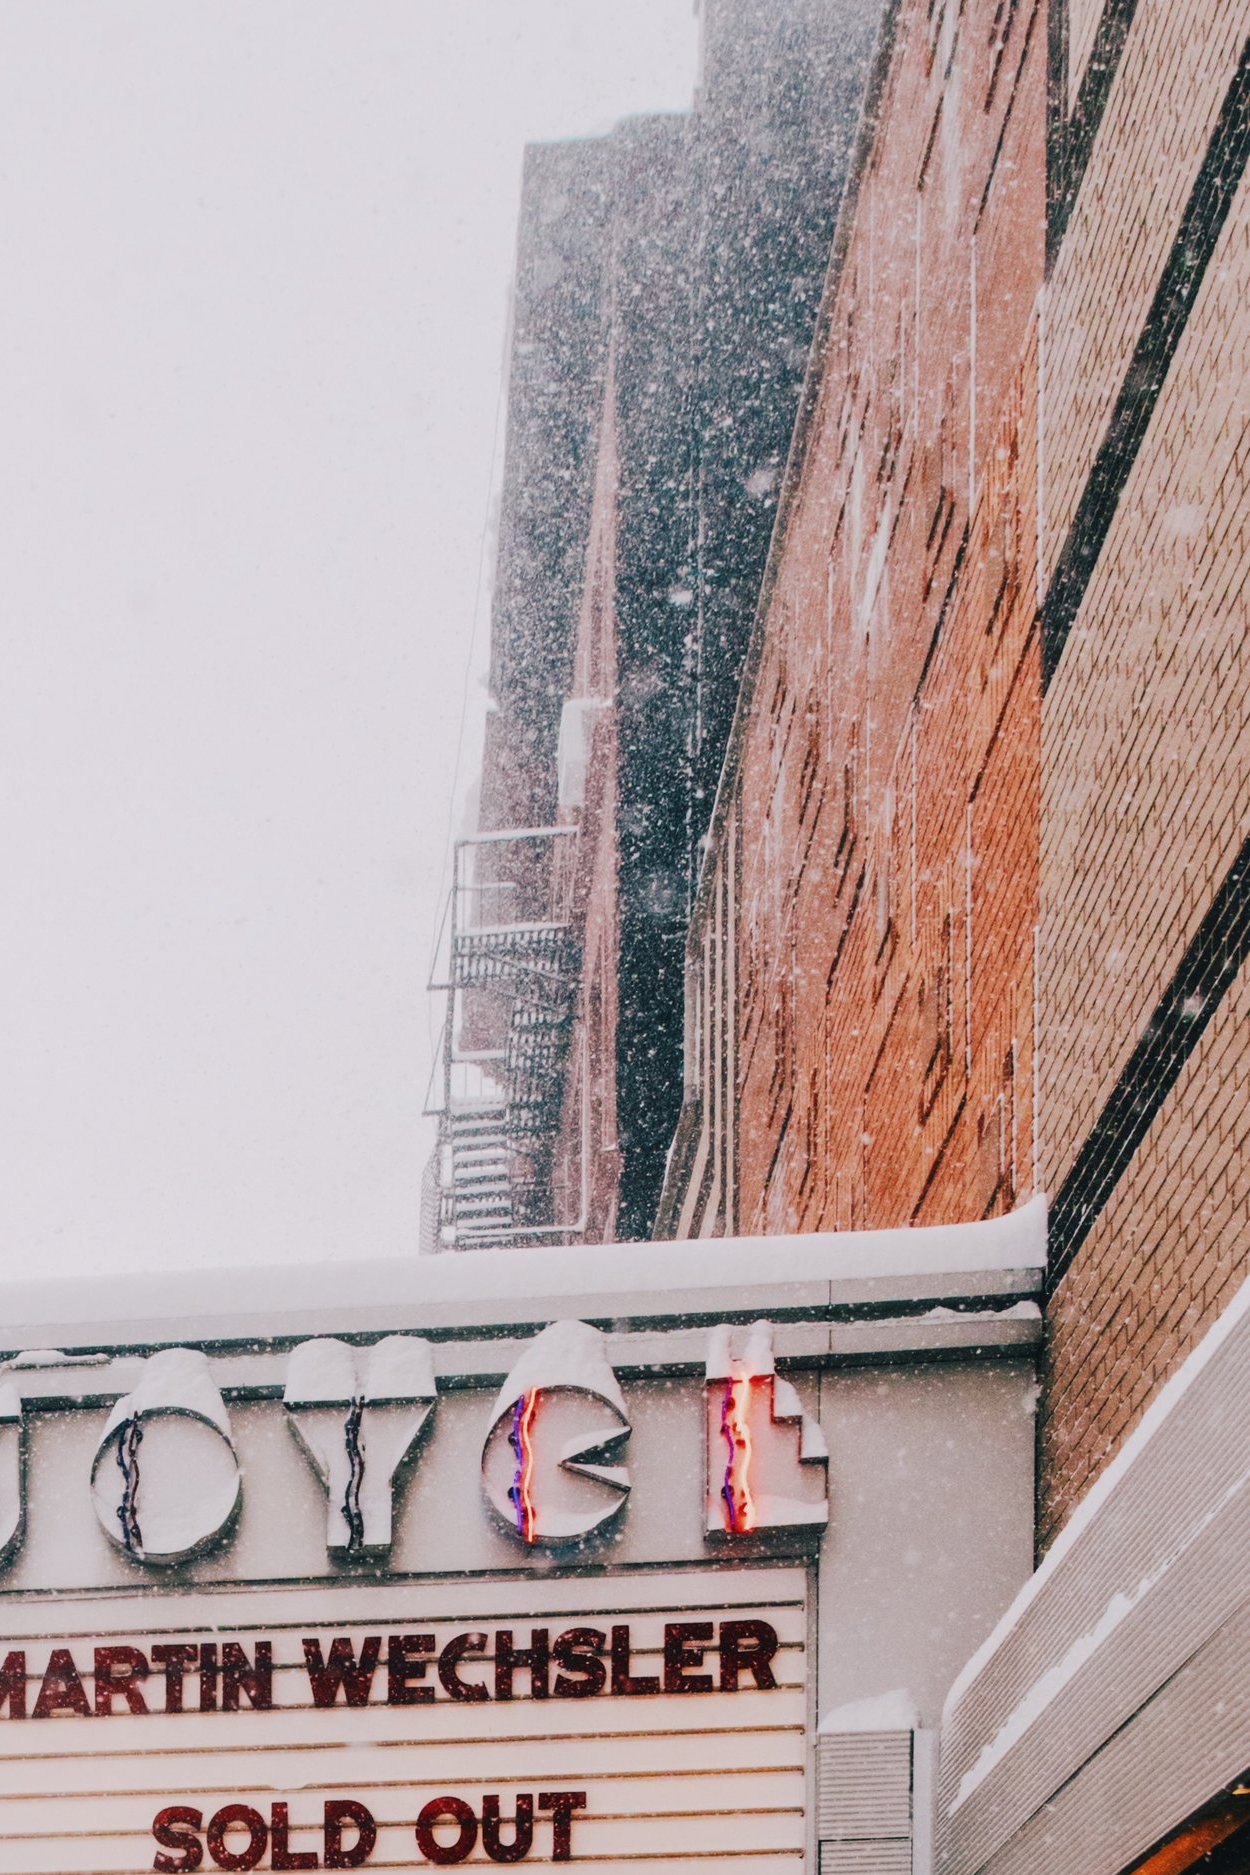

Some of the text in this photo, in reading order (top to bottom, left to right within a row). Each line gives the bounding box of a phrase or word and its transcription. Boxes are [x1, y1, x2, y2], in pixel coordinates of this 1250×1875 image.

[301, 1618, 778, 1708] WECHSLER
[152, 1791, 587, 1874] SOLD OUT
